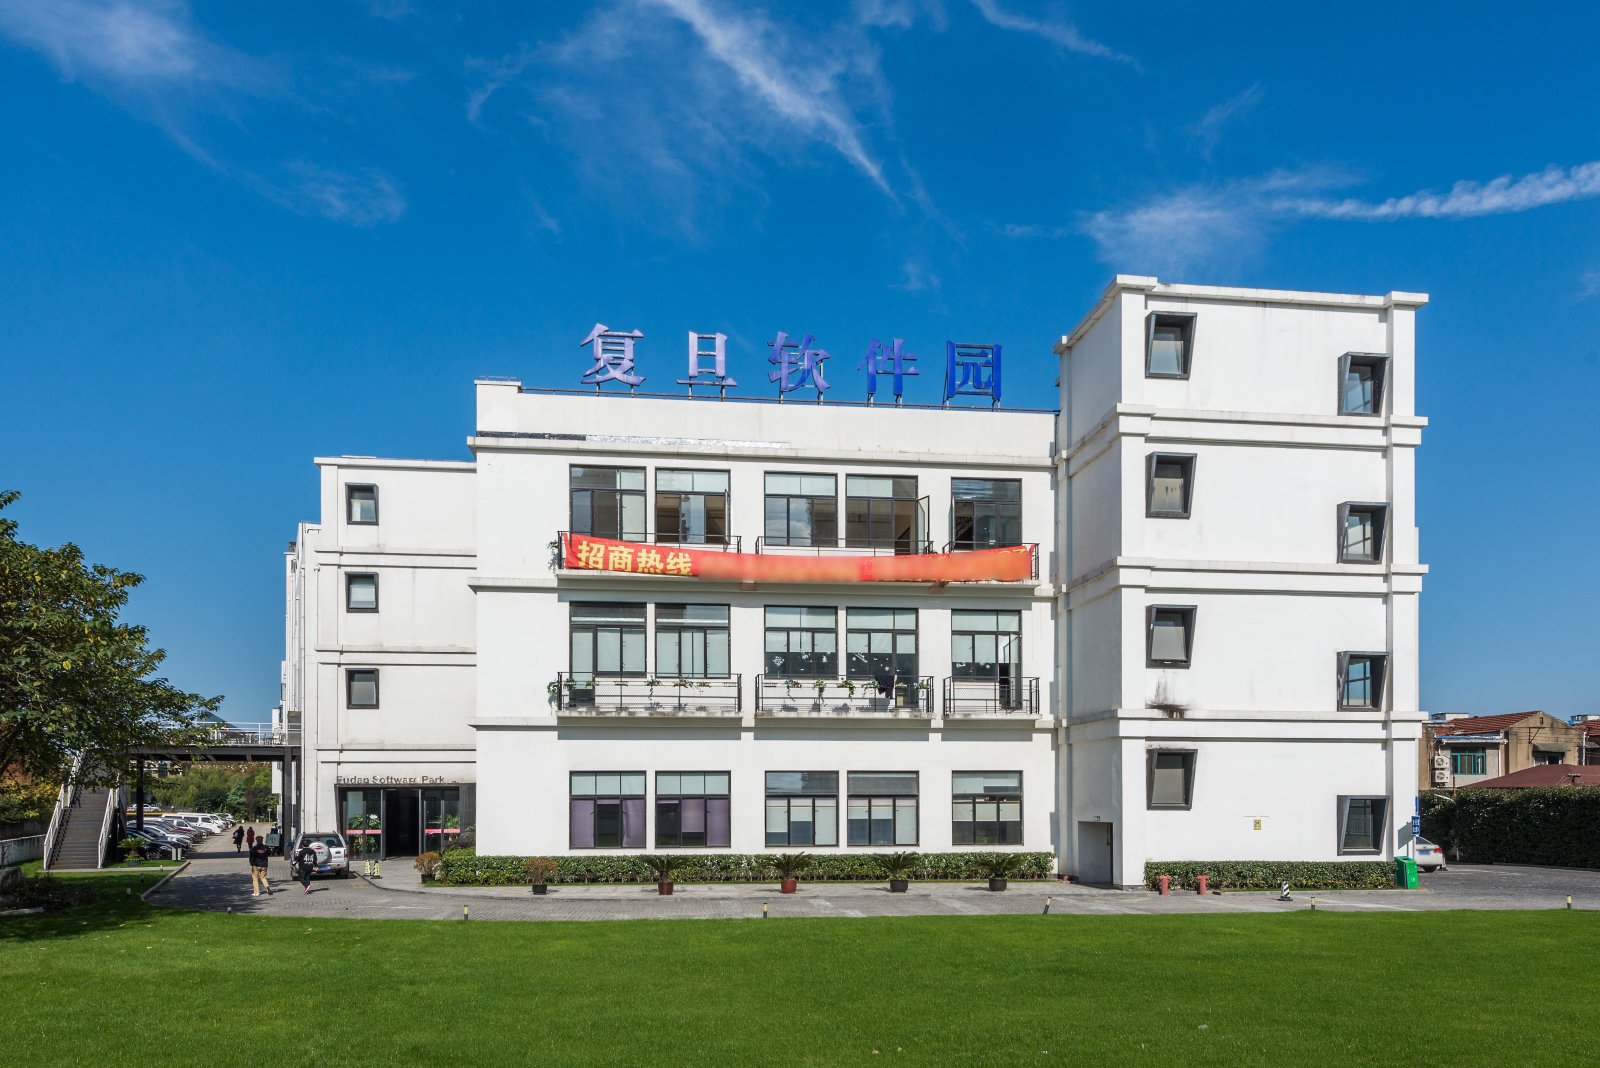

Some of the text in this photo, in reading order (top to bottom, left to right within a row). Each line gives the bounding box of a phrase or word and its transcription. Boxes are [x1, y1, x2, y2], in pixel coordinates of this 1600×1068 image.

[580, 323, 1002, 399] 复旦软件园
[577, 540, 693, 576] 招商热线
[337, 775, 370, 784] Fudan
[421, 775, 445, 784] Park
